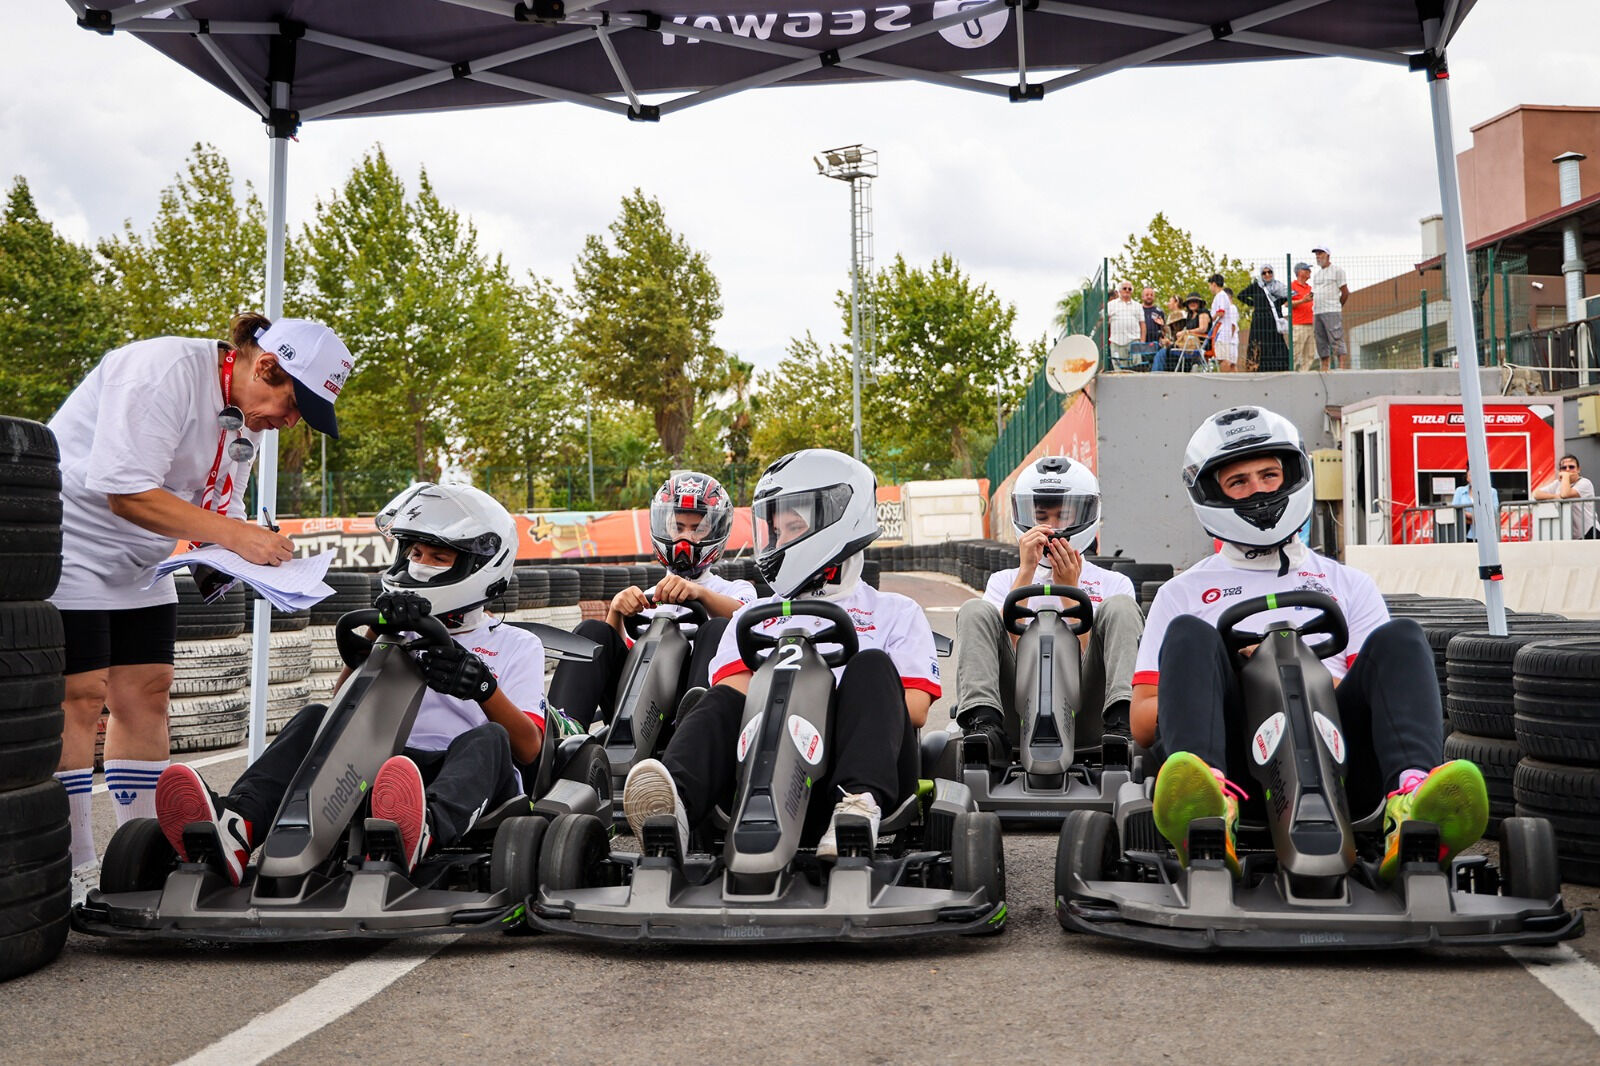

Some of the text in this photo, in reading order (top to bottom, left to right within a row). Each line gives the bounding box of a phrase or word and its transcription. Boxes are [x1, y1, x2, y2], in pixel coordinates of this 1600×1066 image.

[278, 344, 294, 360] FIA
[773, 644, 804, 671] 2
[322, 762, 362, 825] ninebot
[1298, 932, 1345, 945] ninebot
